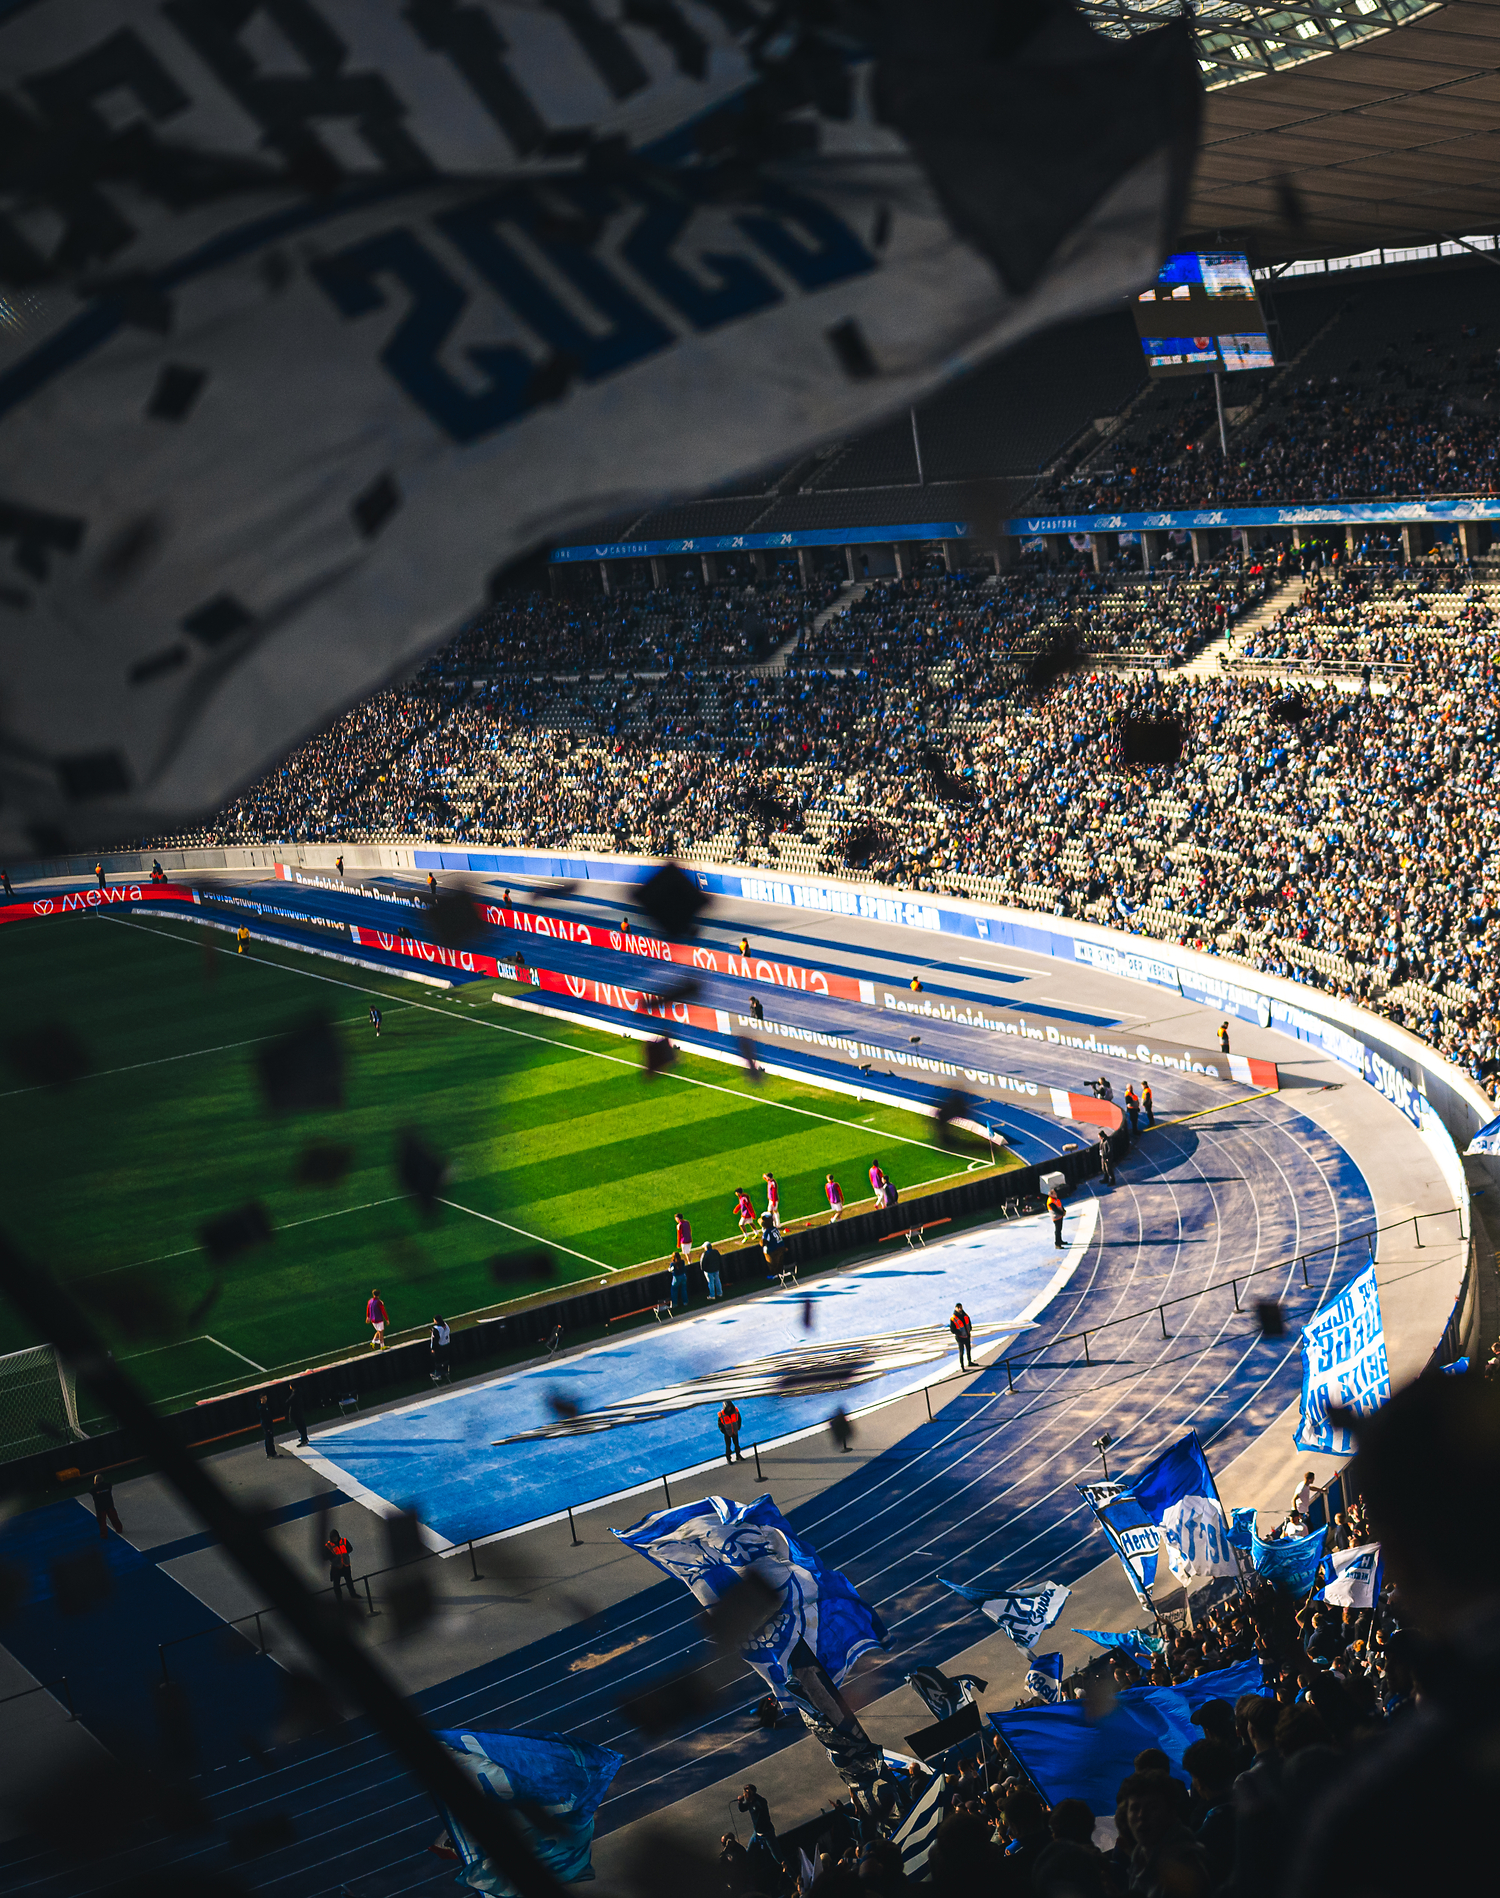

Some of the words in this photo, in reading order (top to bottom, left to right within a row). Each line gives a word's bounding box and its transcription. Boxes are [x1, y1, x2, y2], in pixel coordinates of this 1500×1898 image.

[1041, 519, 1077, 530] CASTORE
[793, 885, 859, 916] BERLINER
[1099, 950, 1116, 965] SIND
[1128, 959, 1143, 972] DER
[1148, 963, 1174, 982] VEREIN
[884, 992, 1019, 1034] Berufskleidung
[1045, 1025, 1219, 1078] Rundum-Service
